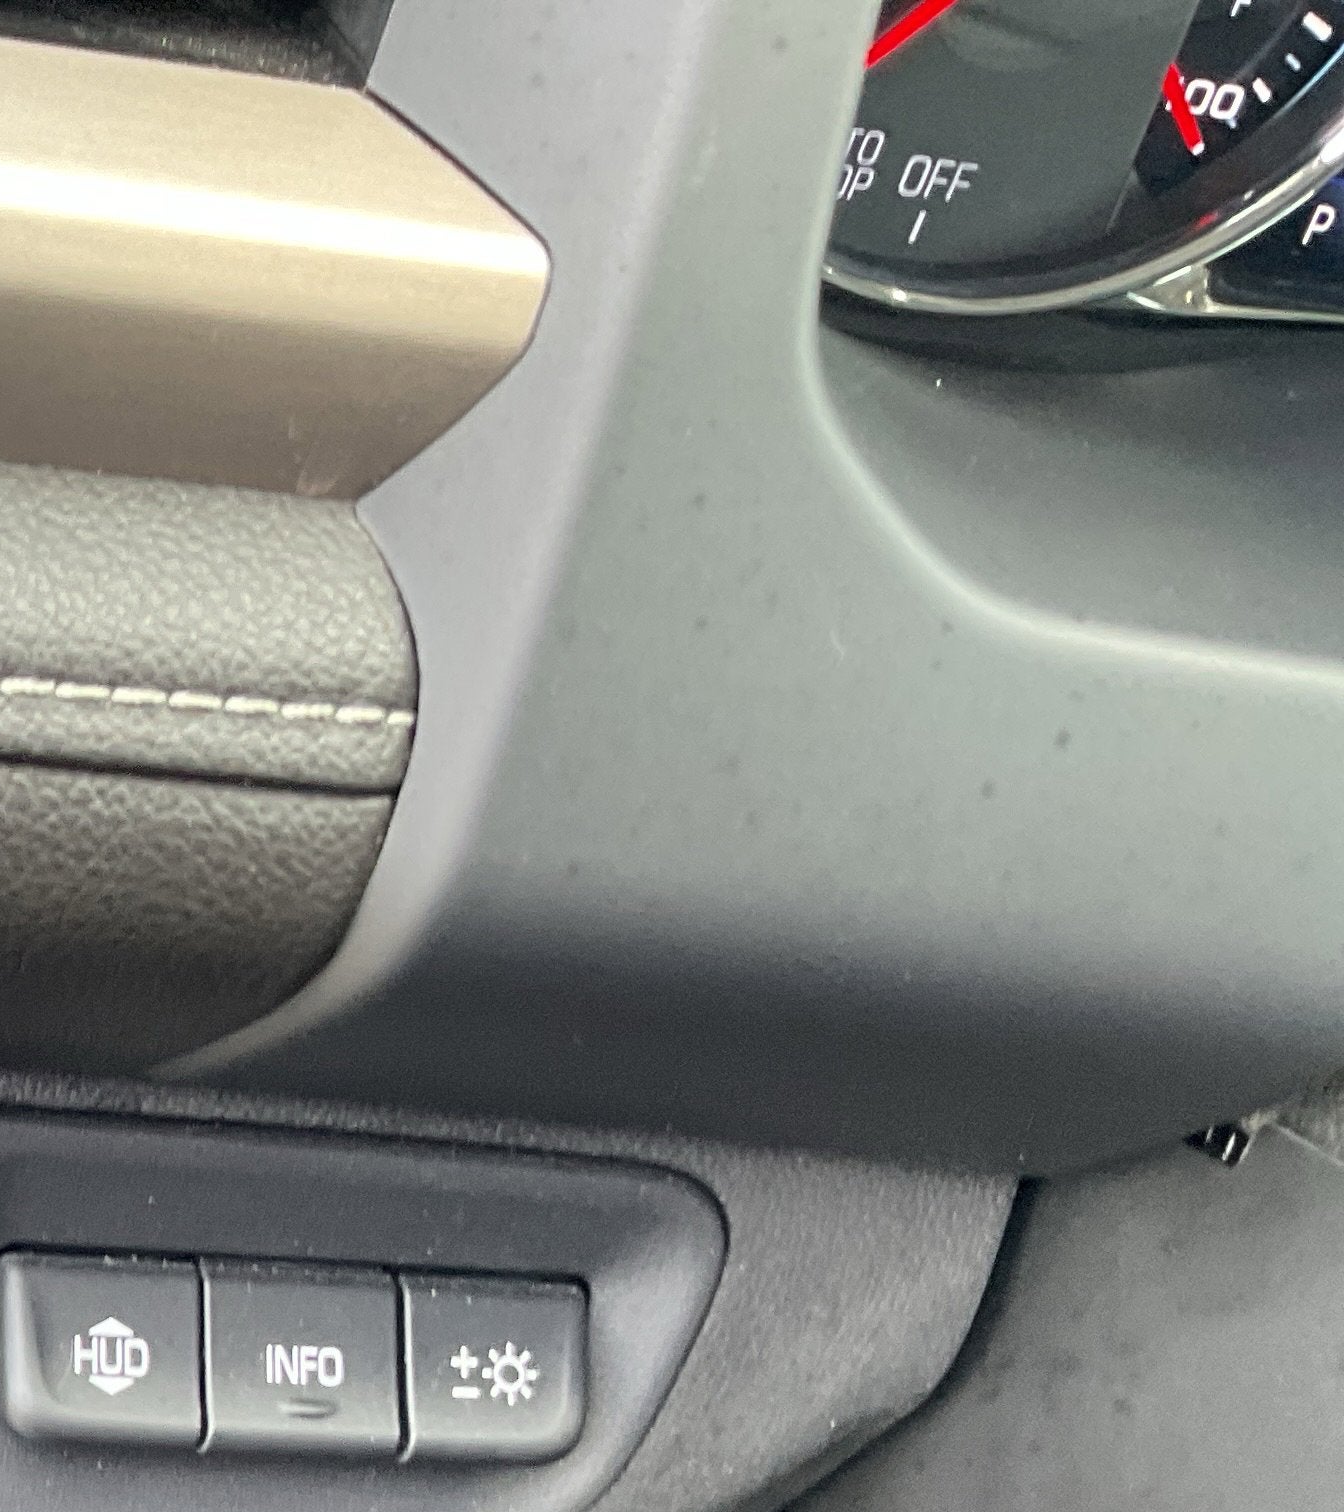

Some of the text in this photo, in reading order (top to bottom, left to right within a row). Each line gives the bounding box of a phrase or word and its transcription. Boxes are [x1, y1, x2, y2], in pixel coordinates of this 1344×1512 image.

[1165, 75, 1245, 120] 00
[844, 127, 886, 166] TO
[897, 154, 980, 203] OFF
[1302, 202, 1337, 246] P
[72, 1333, 151, 1378] HUD
[264, 1343, 344, 1388] INFO
